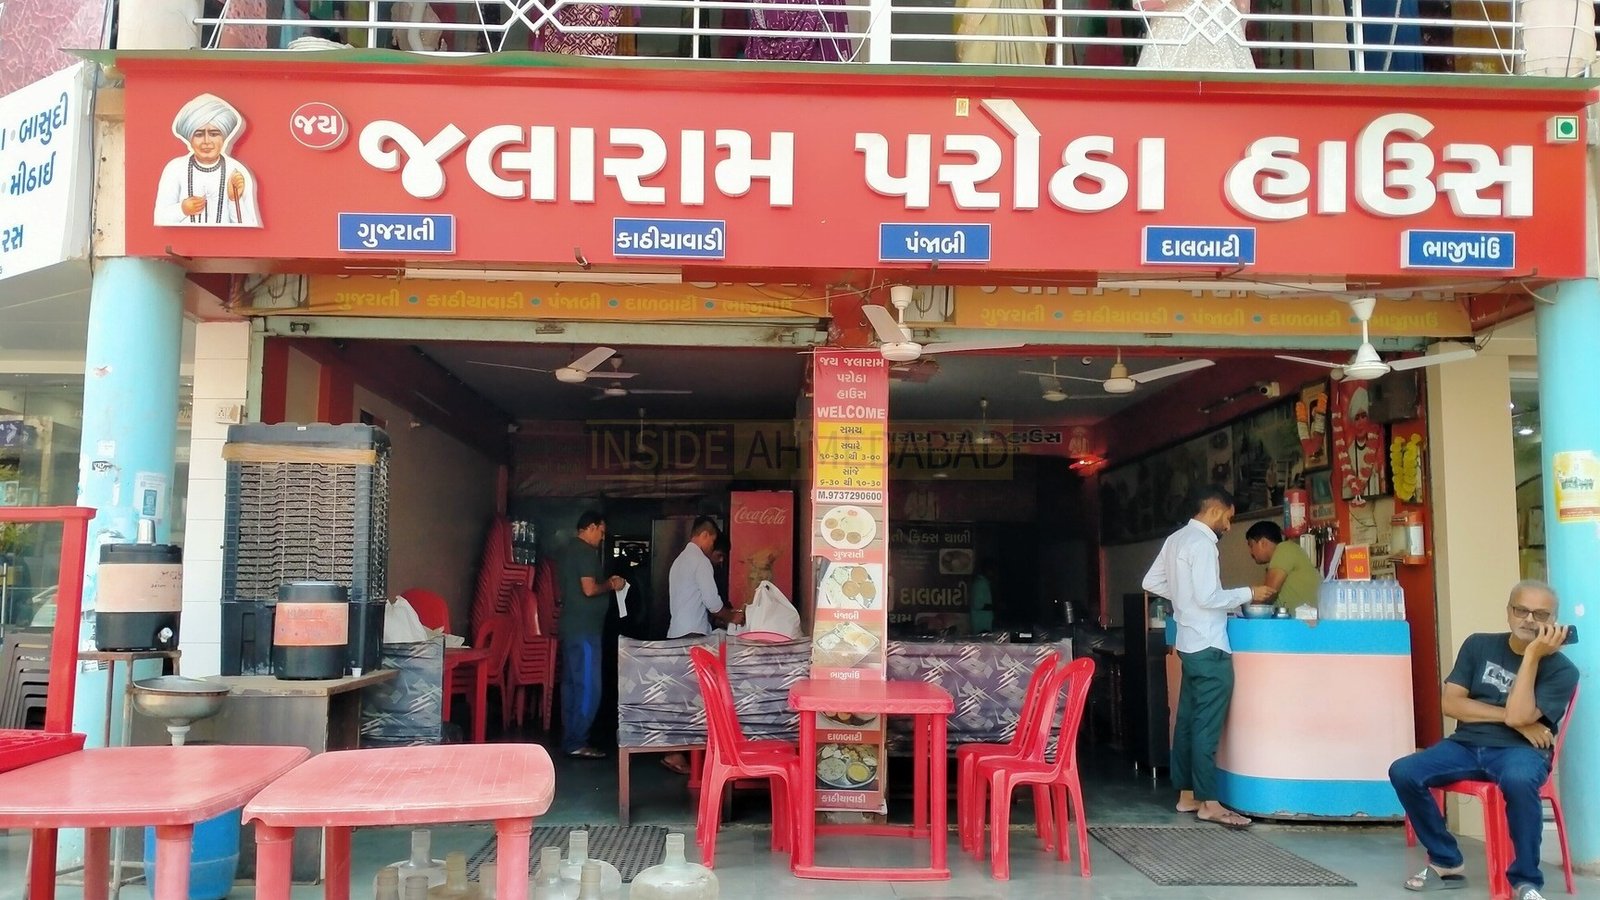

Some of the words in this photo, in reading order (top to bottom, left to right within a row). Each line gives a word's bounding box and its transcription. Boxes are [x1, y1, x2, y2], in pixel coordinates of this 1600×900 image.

[19, 91, 69, 146] બાસુદી
[293, 113, 339, 137] જય
[357, 119, 796, 209] જલારામ
[855, 98, 1167, 214] પરોઠા
[1222, 112, 1536, 221] હાઉસ
[357, 217, 436, 248] ગુજરાતી
[615, 225, 723, 252] કાઠીયાવાડી
[904, 230, 966, 255] પંજાબી
[1161, 235, 1241, 258] દાલબાટી
[1422, 236, 1501, 264] ભાજીપાંઉ
[334, 288, 400, 311] ગુજરાતી
[426, 289, 525, 310] કાઠીયાવાડી
[548, 292, 601, 312] પંજાબી
[980, 303, 1045, 327] ગુજરાતી
[1070, 306, 1168, 325] કાઠીયાવાડી
[1191, 308, 1245, 326] પંજાબી
[819, 356, 839, 367] જય
[843, 356, 885, 368] જલારામ
[836, 371, 867, 383] પરોઠા
[836, 388, 867, 400] હાઉસ
[816, 405, 886, 419] WELCOME
[839, 425, 863, 434] સમય
[840, 440, 861, 451] સવારે
[842, 466, 860, 476] સાંજે
[817, 490, 882, 501] M.9737290600
[832, 549, 865, 562] ગુજરાતી
[833, 610, 860, 620] પંજાબી
[827, 731, 863, 741] દાળબાટી
[820, 793, 866, 804] કાઠીયાવાડી
